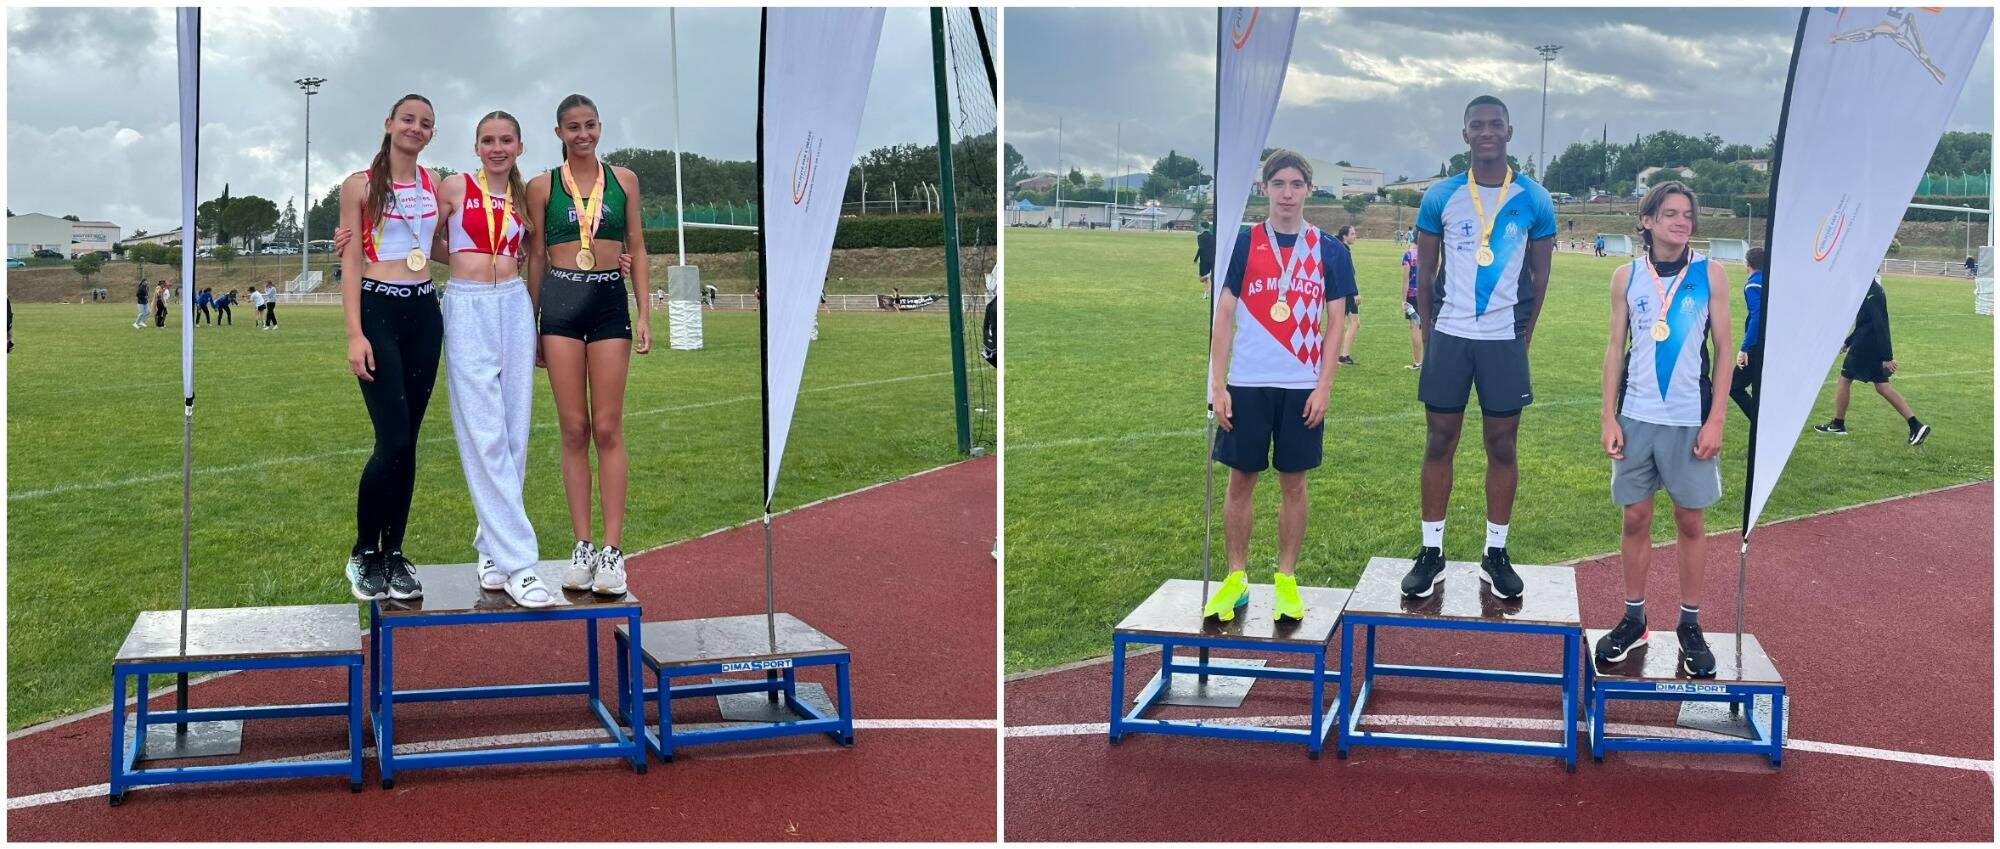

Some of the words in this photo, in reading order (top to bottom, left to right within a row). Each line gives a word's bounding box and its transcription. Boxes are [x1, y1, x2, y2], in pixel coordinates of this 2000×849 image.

[466, 198, 480, 210] AS
[551, 269, 585, 282] NIKE
[586, 271, 621, 283] PRO
[375, 284, 412, 298] PRO
[1248, 279, 1263, 296] AS
[1266, 277, 1320, 299] MNACO
